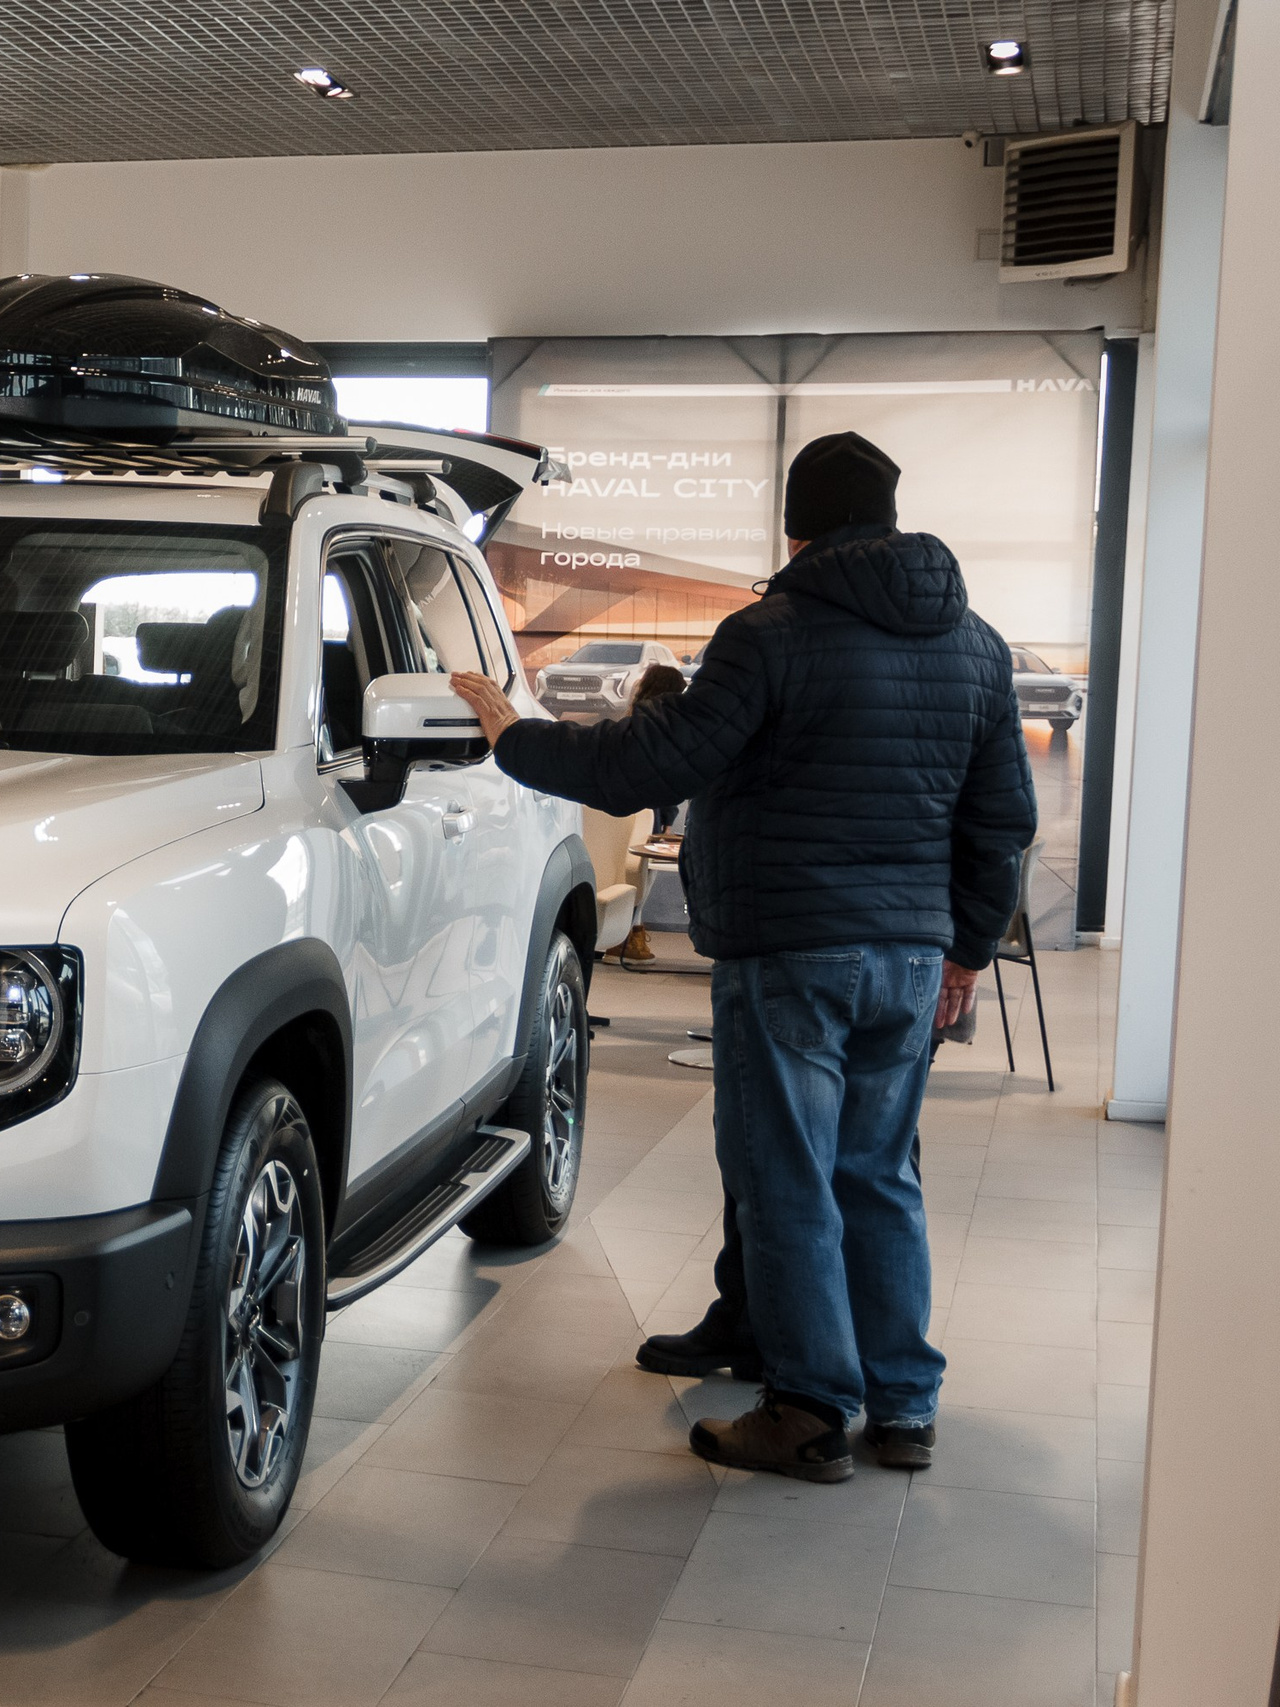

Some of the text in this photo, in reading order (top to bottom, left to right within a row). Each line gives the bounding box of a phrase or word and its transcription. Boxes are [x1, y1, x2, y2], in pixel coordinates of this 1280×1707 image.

[1016, 378, 1100, 392] HAVA
[296, 387, 322, 405] HAVAL
[542, 477, 770, 498] HAVAL CITY
[541, 522, 767, 544] Новые правила
[540, 550, 641, 570] города
